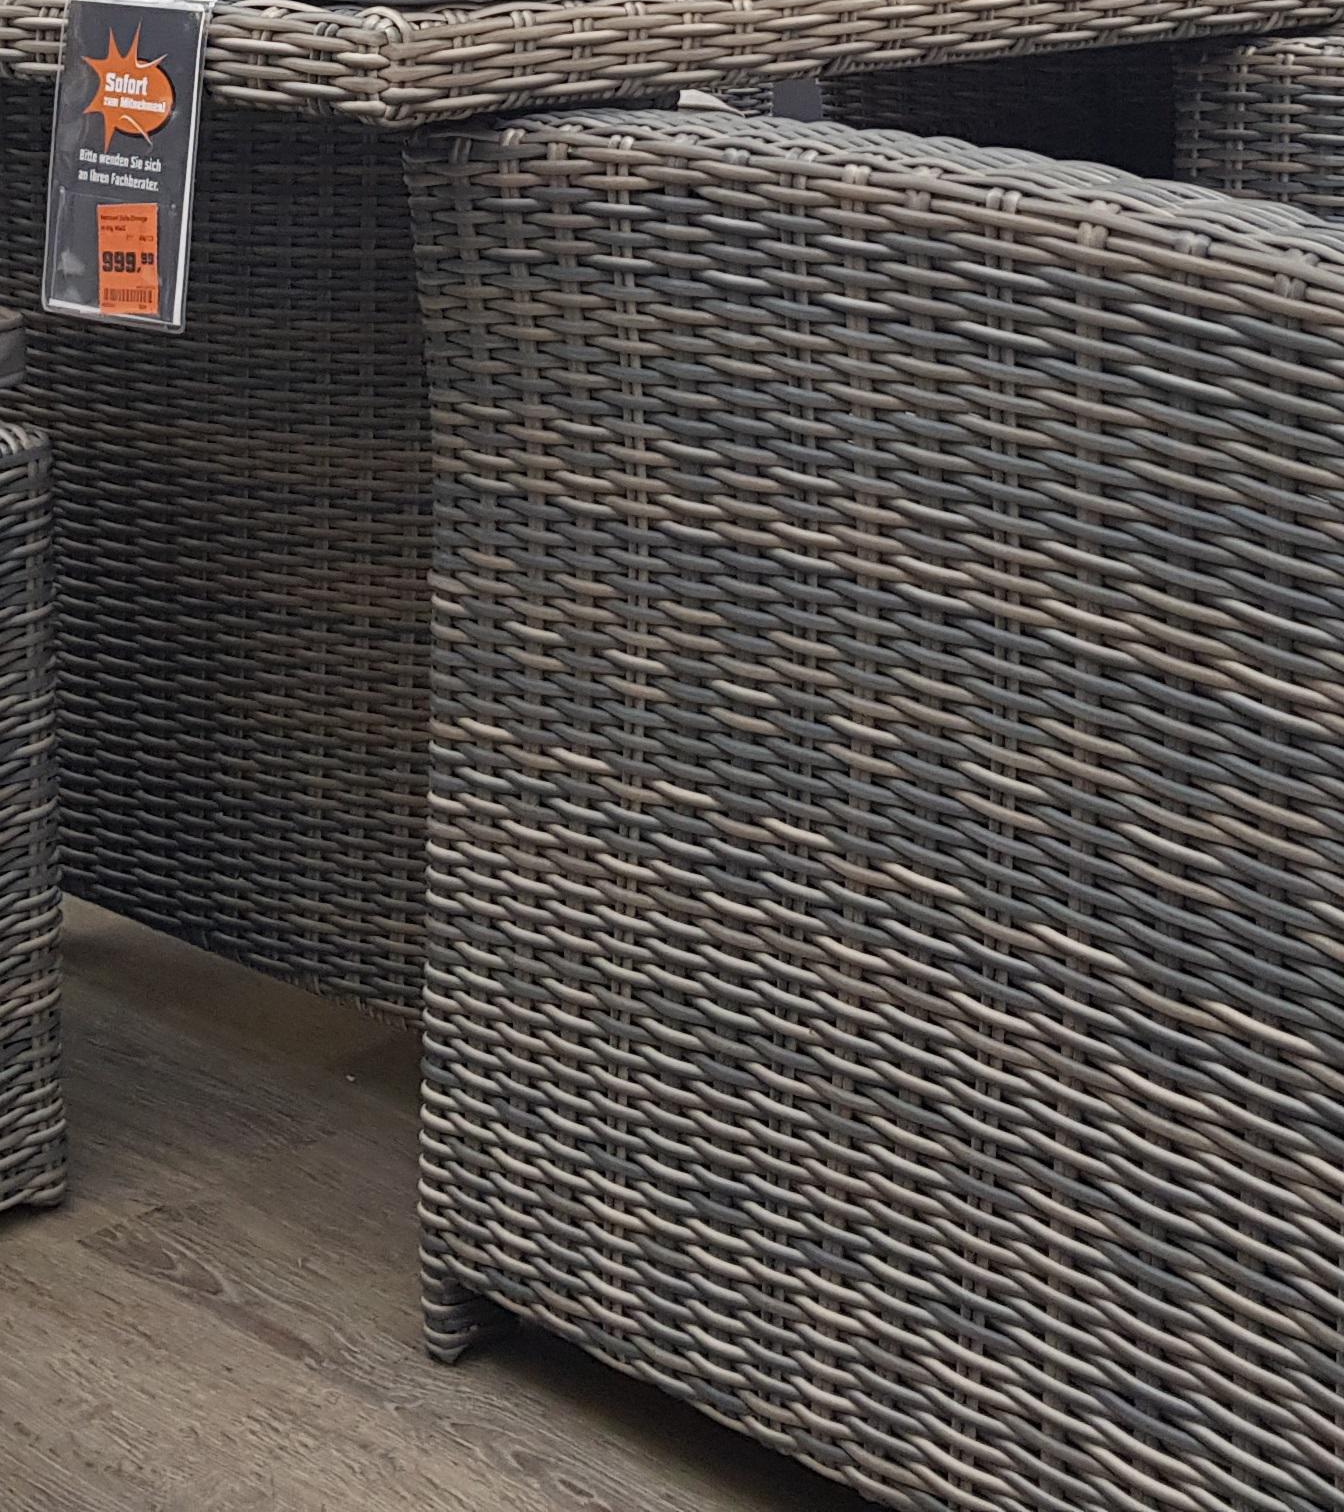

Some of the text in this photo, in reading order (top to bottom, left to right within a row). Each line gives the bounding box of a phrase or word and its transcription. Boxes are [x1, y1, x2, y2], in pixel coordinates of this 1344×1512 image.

[105, 72, 148, 95] Sofort
[79, 149, 161, 172] Bitte wenden Sie sich
[78, 169, 159, 192] an Ihren Fachberater.
